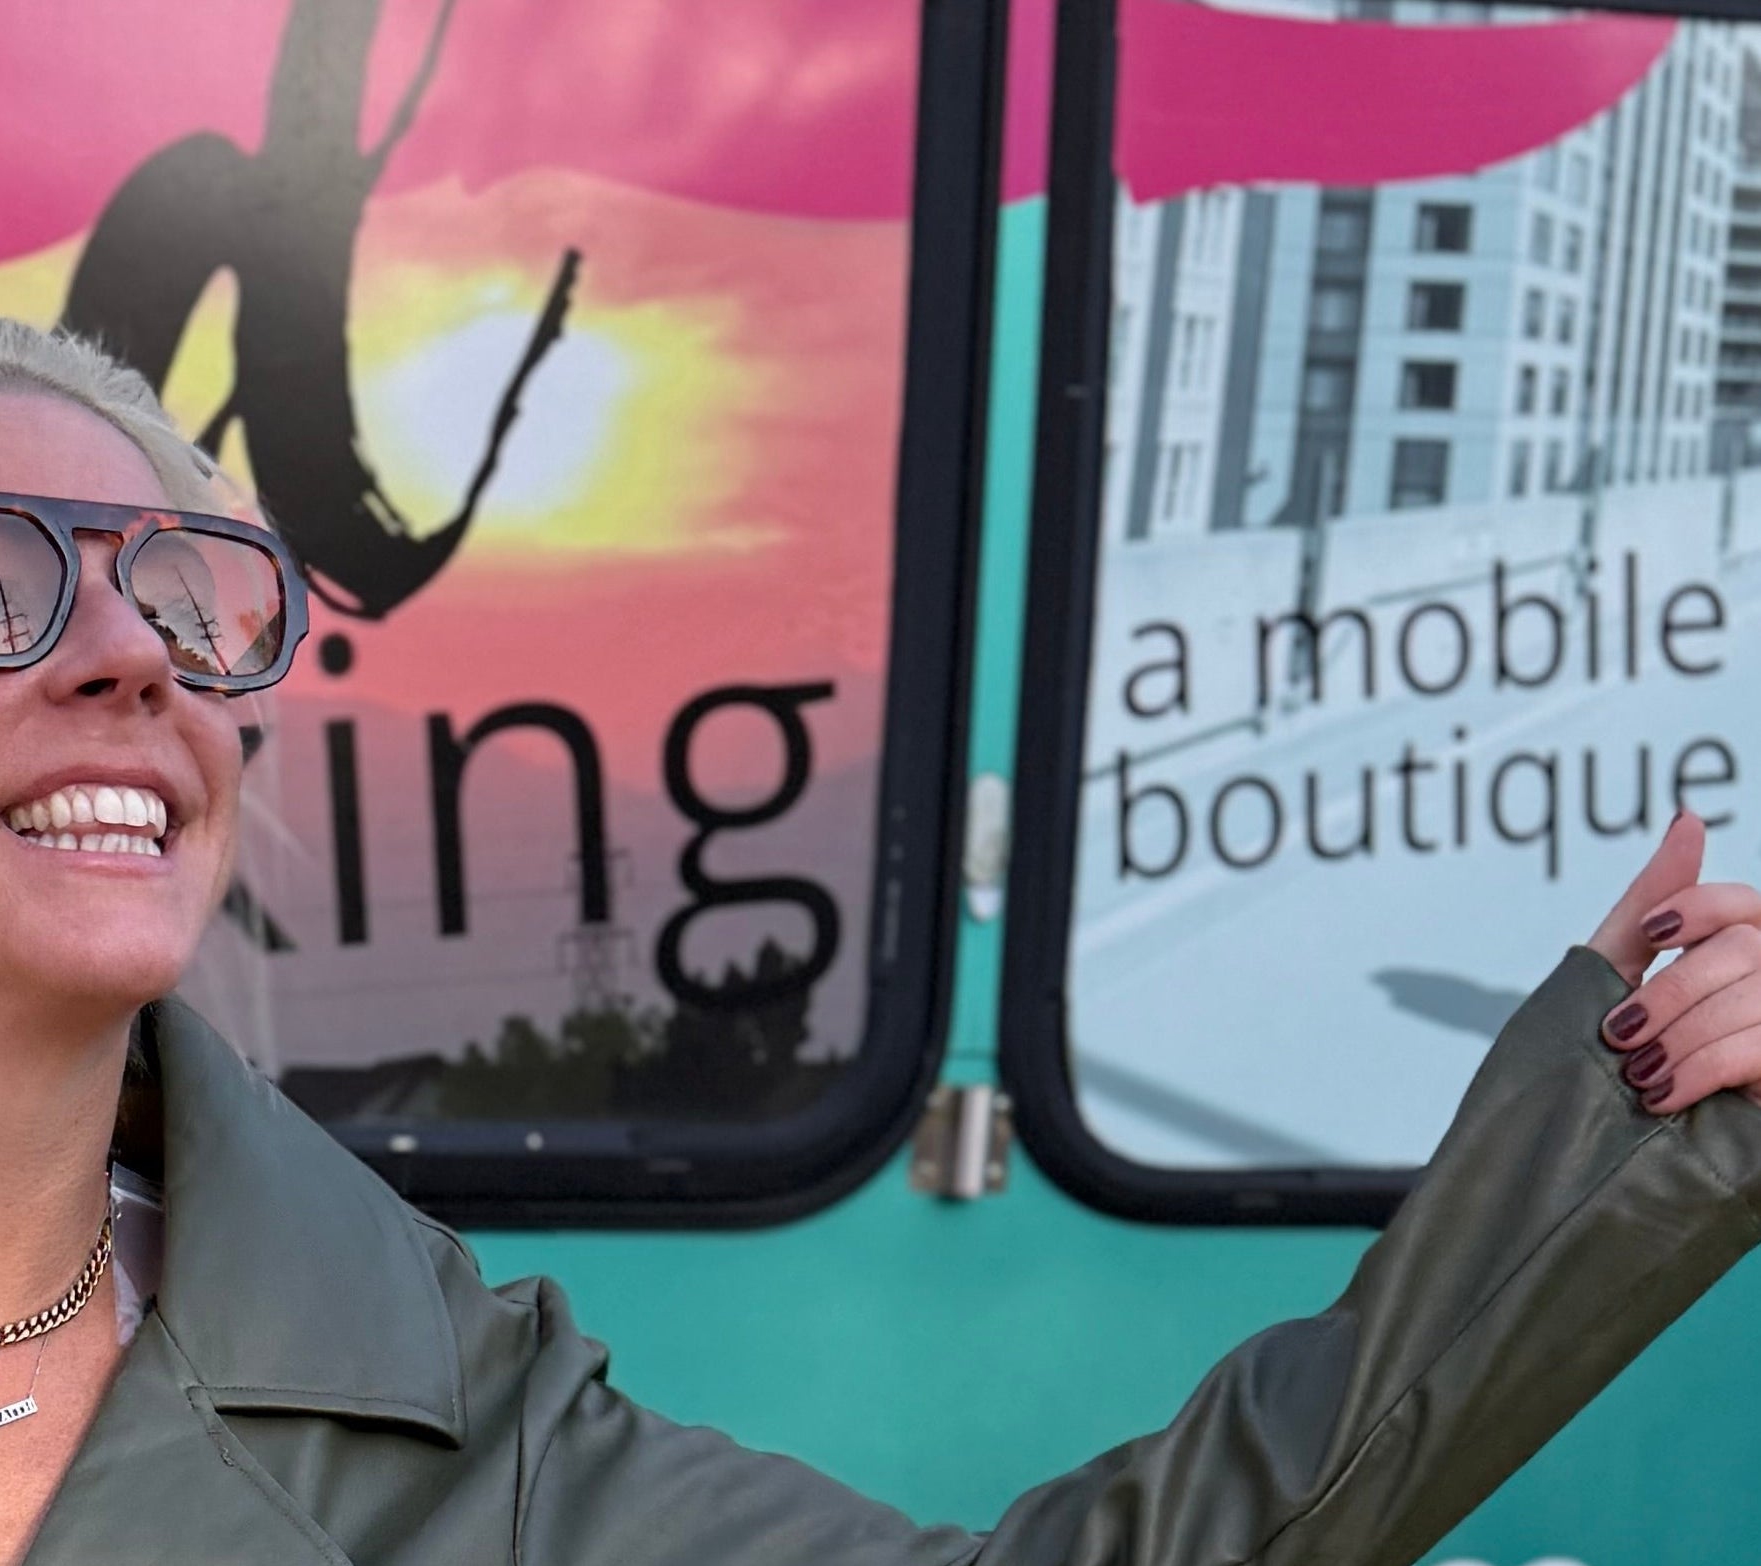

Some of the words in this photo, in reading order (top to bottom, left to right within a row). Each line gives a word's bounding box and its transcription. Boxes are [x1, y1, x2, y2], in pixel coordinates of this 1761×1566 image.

[1121, 619, 1190, 720] a
[1255, 550, 1727, 708] mobile
[1114, 727, 1740, 881] boutique
